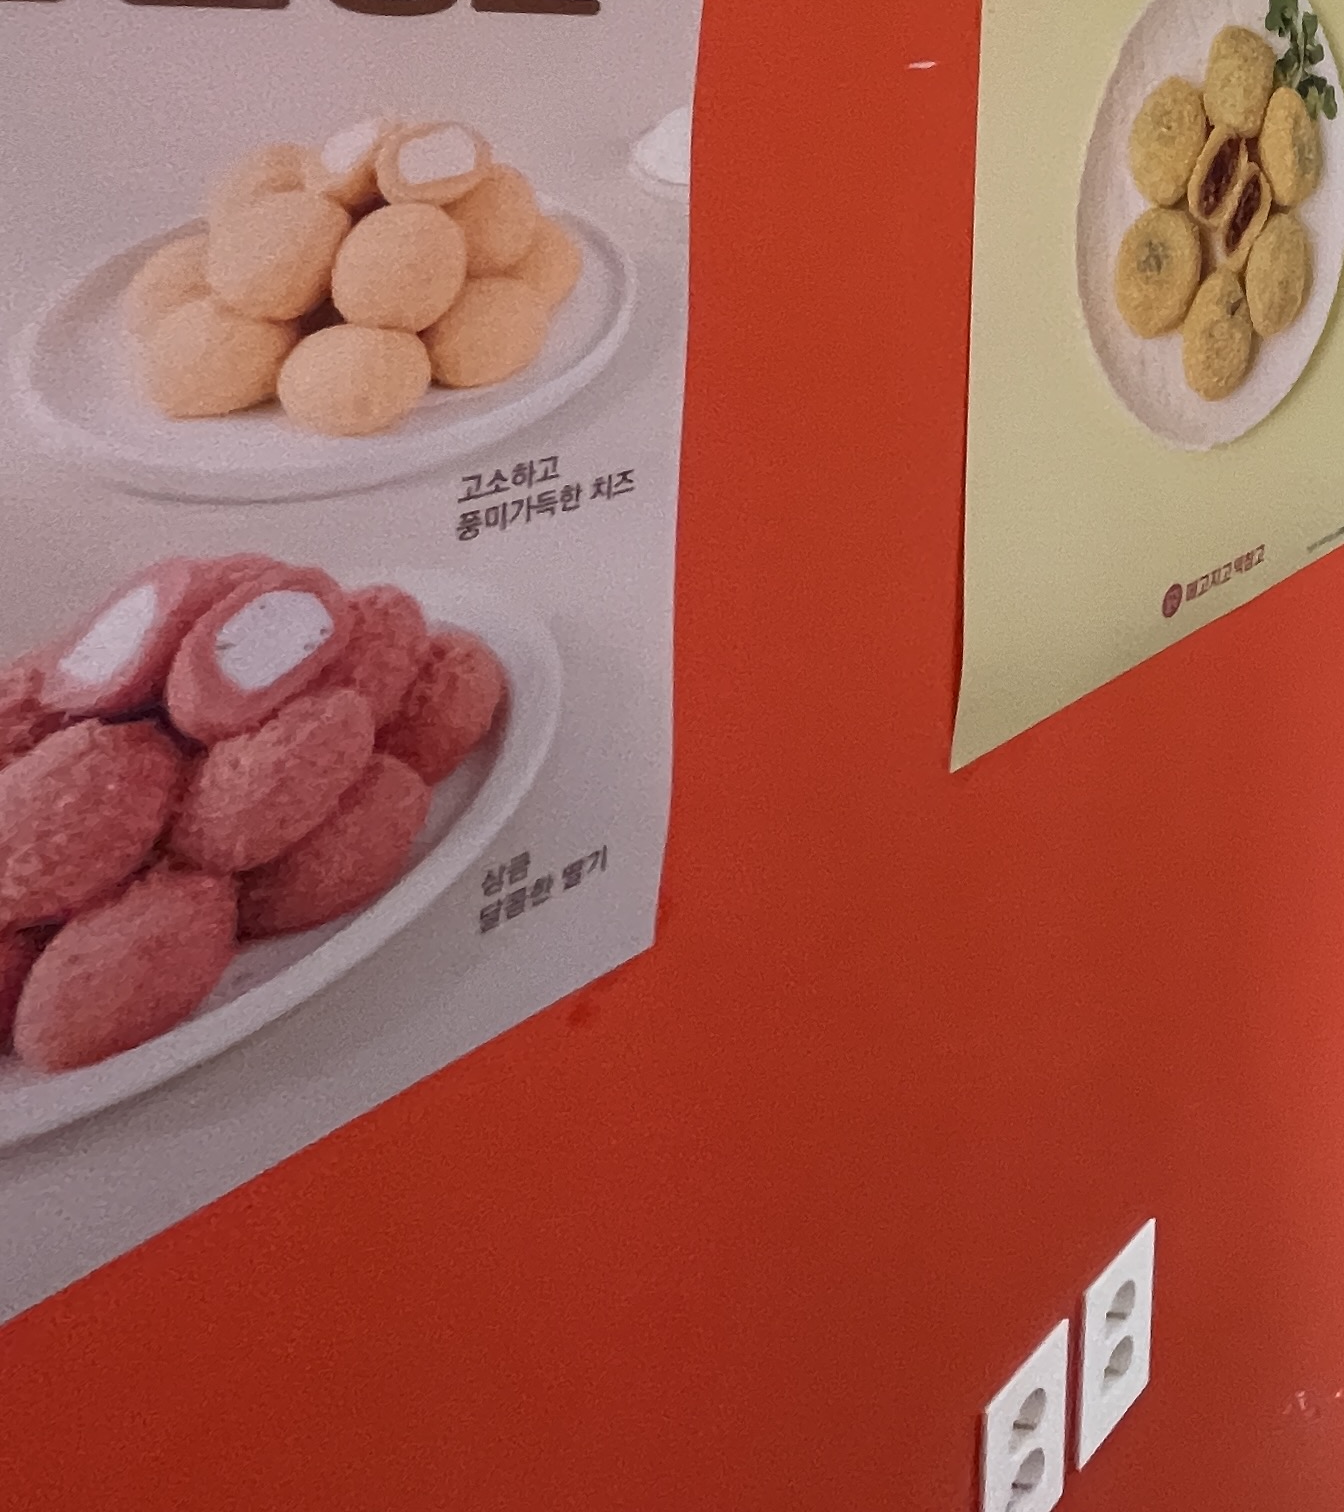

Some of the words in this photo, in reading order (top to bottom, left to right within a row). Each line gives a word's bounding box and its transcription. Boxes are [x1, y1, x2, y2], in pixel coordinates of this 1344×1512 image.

[457, 455, 560, 504] 고소하고
[456, 482, 582, 542] 풍미가득한
[589, 469, 636, 500] 치즈
[562, 844, 608, 892] 딸기
